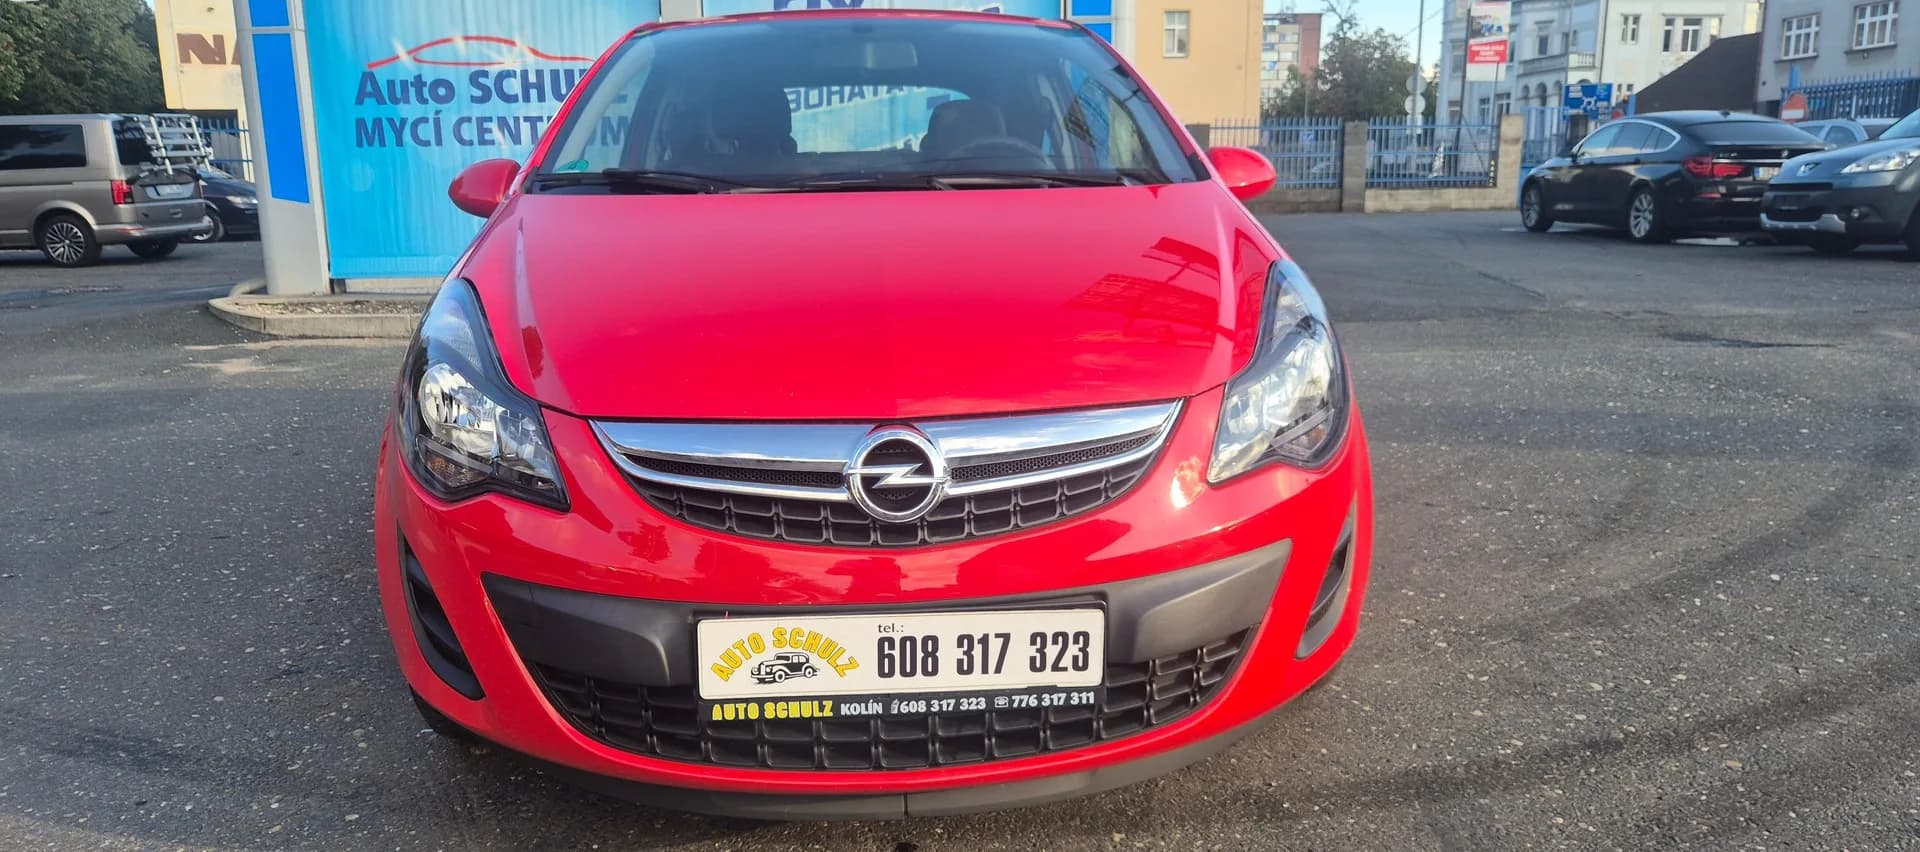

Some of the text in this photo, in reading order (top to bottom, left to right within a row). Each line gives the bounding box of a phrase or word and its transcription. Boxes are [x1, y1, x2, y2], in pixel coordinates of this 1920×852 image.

[354, 68, 627, 106] Auto SCHU
[355, 110, 443, 148] MYCÍ
[877, 623, 904, 633] tel.:
[710, 626, 860, 682] AUTO SCHULZ
[877, 631, 1090, 678] 608 317 323
[712, 699, 883, 720] AUTO SCHULZ KOLÍN
[900, 697, 986, 713] 608 317 323
[1012, 691, 1095, 708] 776 317 311
